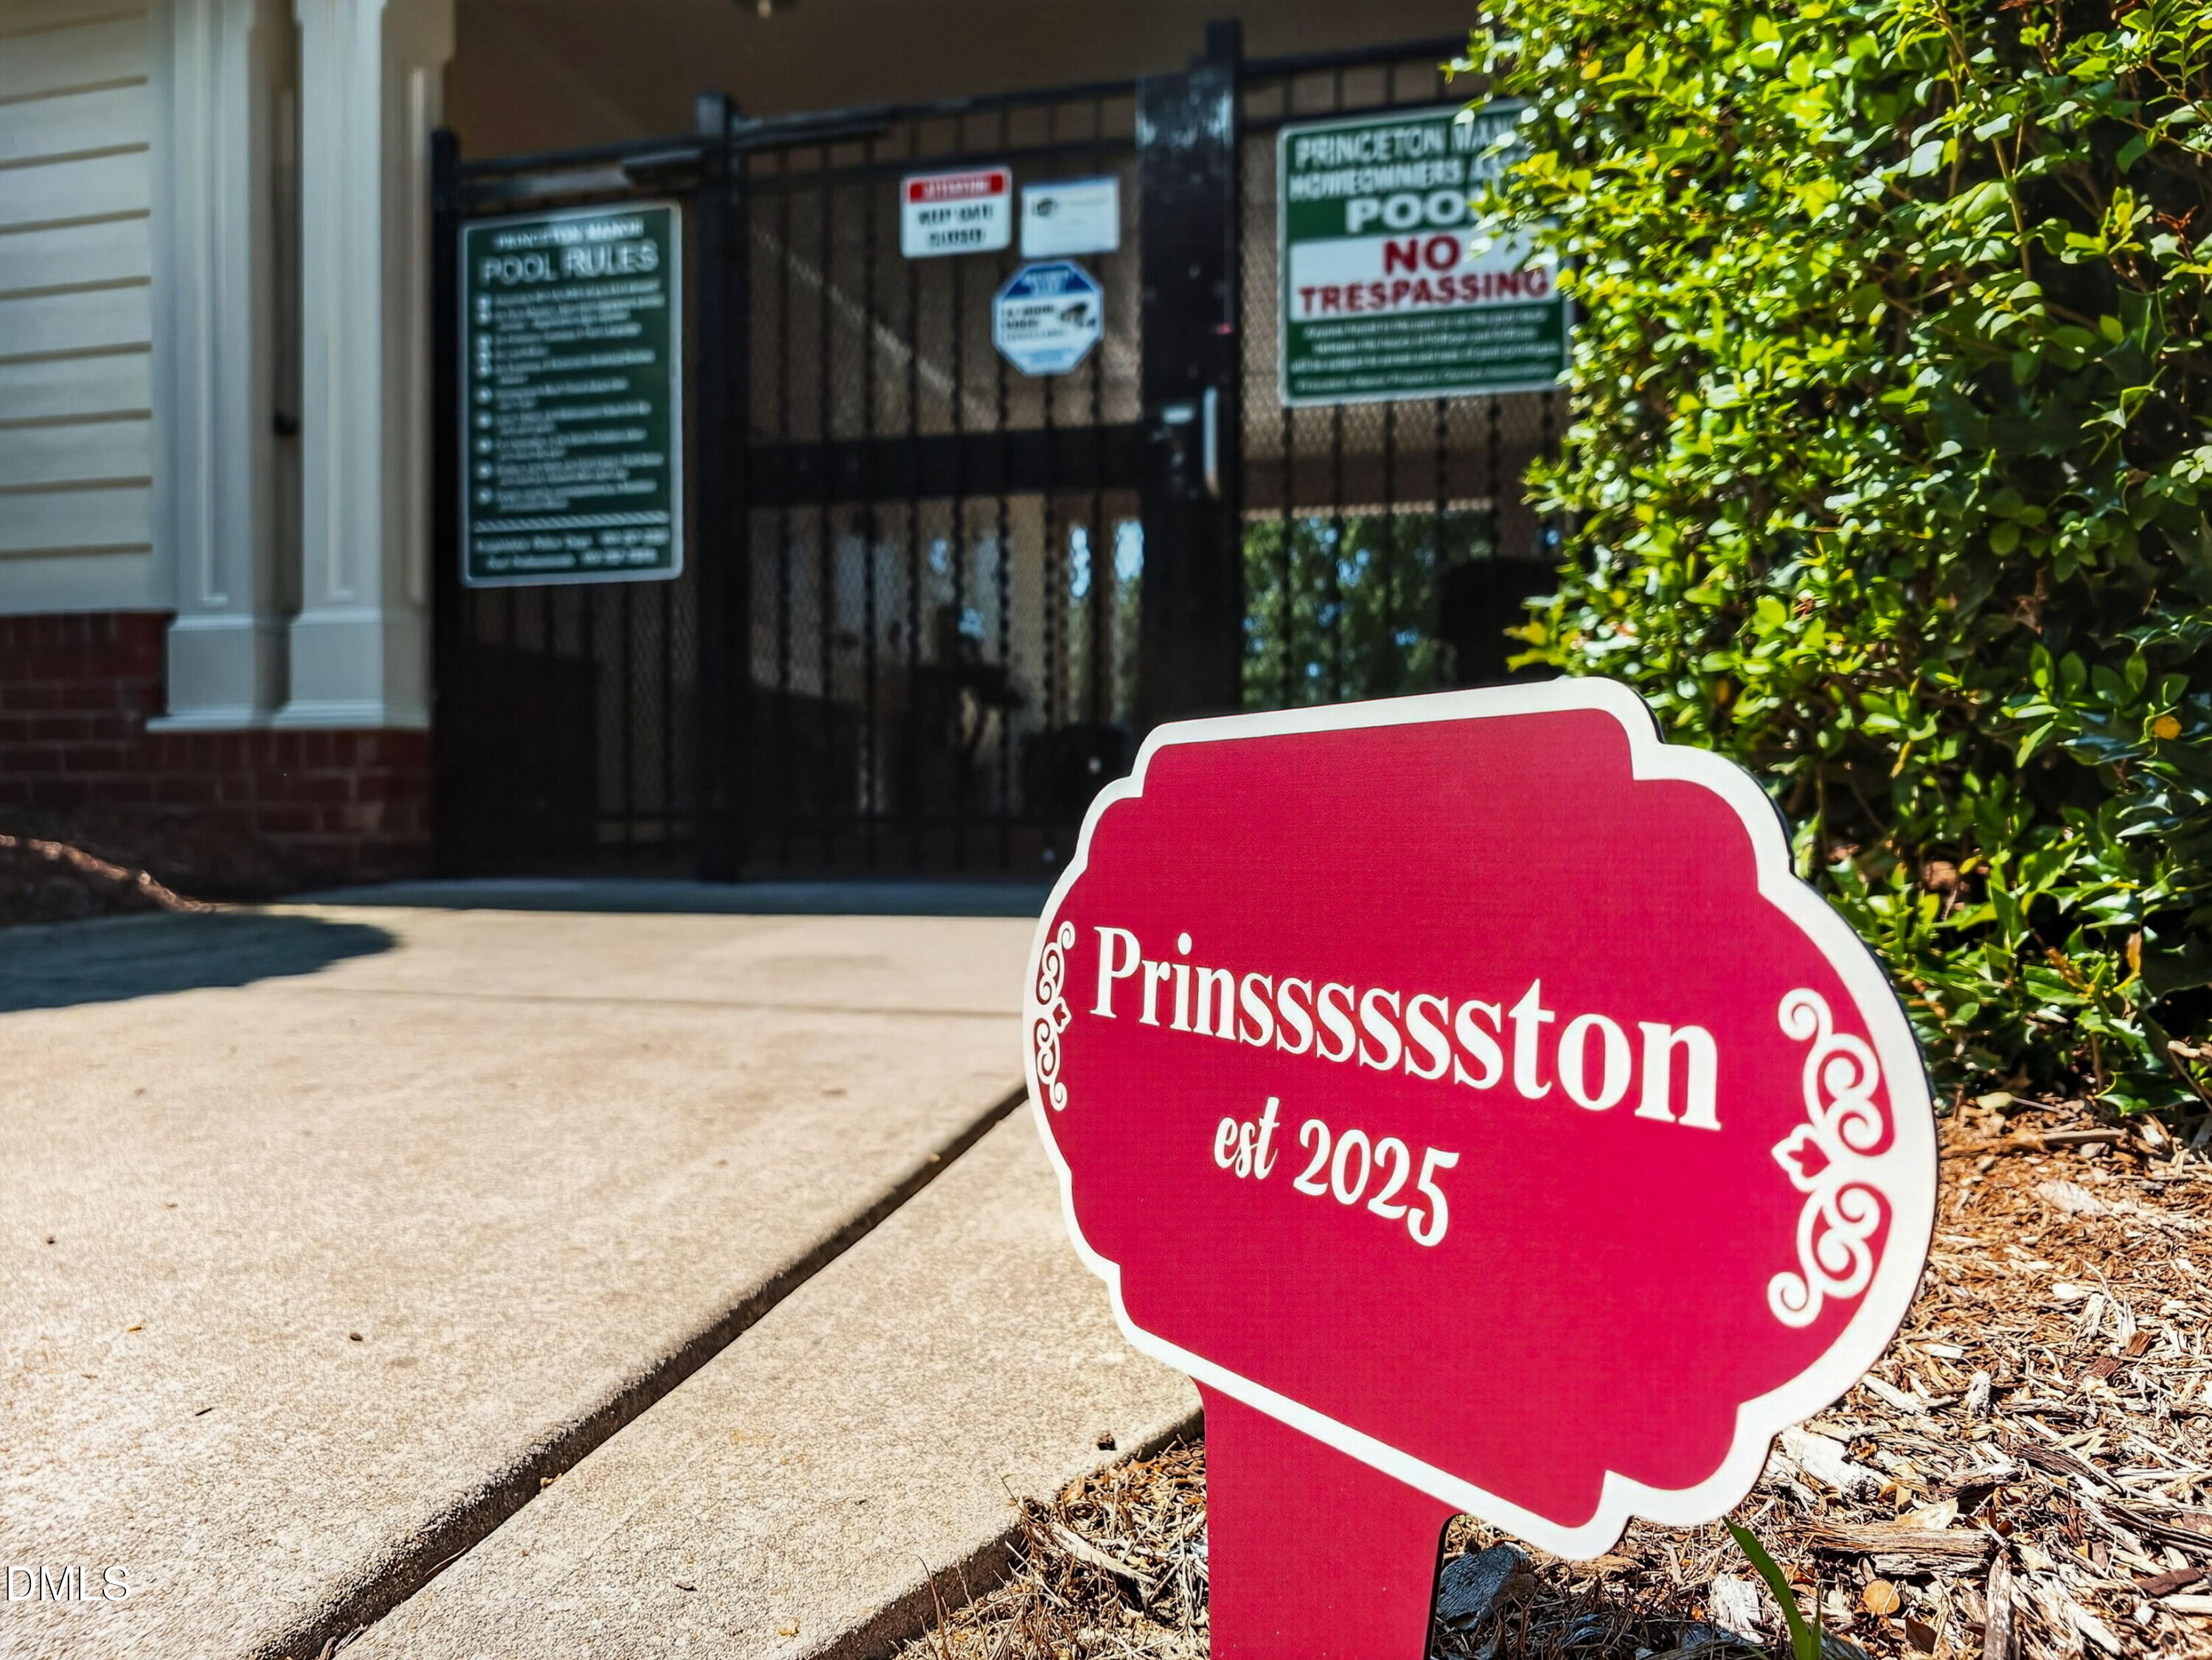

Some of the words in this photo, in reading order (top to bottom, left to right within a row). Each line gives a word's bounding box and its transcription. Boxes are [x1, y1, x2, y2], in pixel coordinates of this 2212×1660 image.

[1295, 125, 1446, 170] PRINCETON
[1290, 158, 1462, 199] HOMEOWNERS
[480, 253, 557, 285] POOL
[561, 239, 658, 279] RULES
[1382, 235, 1461, 275] NO
[1298, 268, 1548, 315] TRESPASSING
[1089, 925, 1723, 1131] Prinsssssston
[1213, 1095, 1281, 1181] est
[1292, 1117, 1461, 1248] 2025
